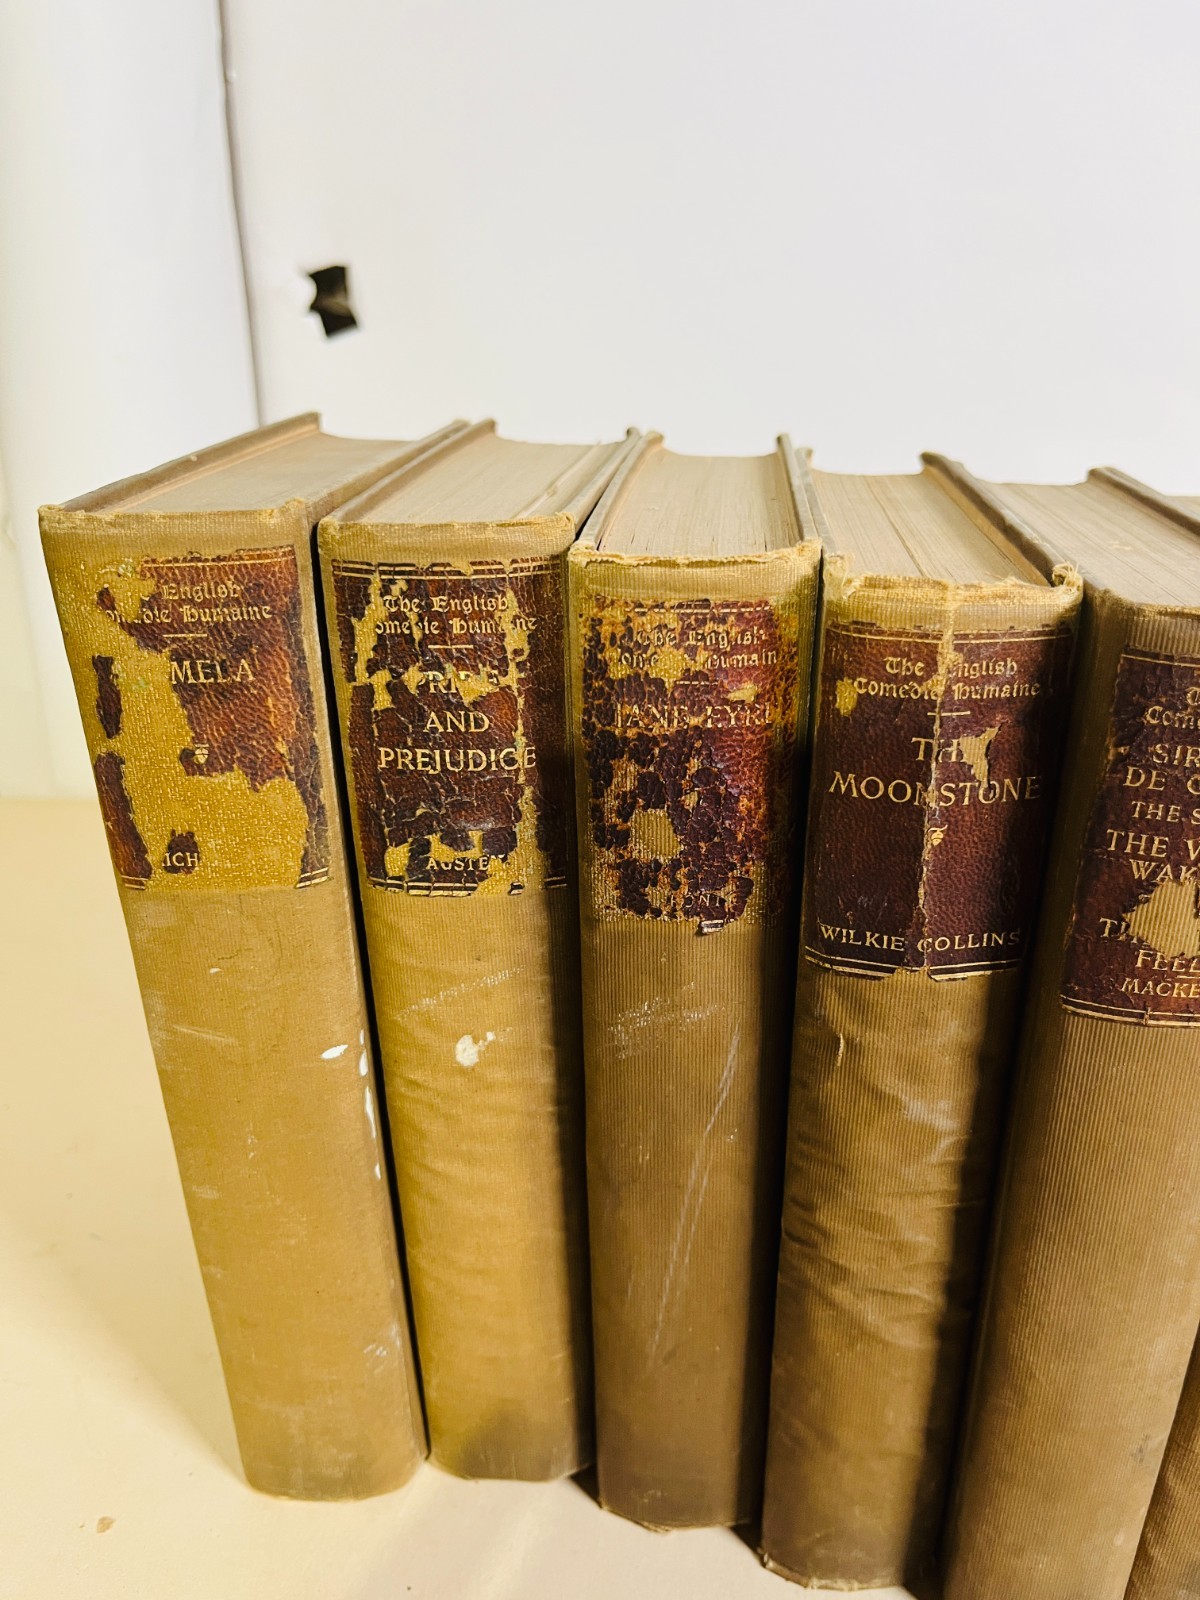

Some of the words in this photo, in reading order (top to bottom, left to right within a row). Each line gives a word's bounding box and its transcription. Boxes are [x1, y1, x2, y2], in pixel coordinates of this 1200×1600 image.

[384, 595, 421, 613] The
[430, 594, 509, 614] English
[171, 659, 256, 685] MELA
[883, 656, 925, 676] The
[949, 658, 1018, 679] nglish
[952, 682, 1041, 701] Humaine
[423, 711, 490, 733] AND
[377, 747, 537, 775] PREJUDICE
[1122, 765, 1168, 791] DE
[1131, 800, 1181, 823] THE
[1106, 828, 1170, 858] THE
[820, 924, 905, 952] WILKIE
[917, 929, 1020, 953] COLLINS
